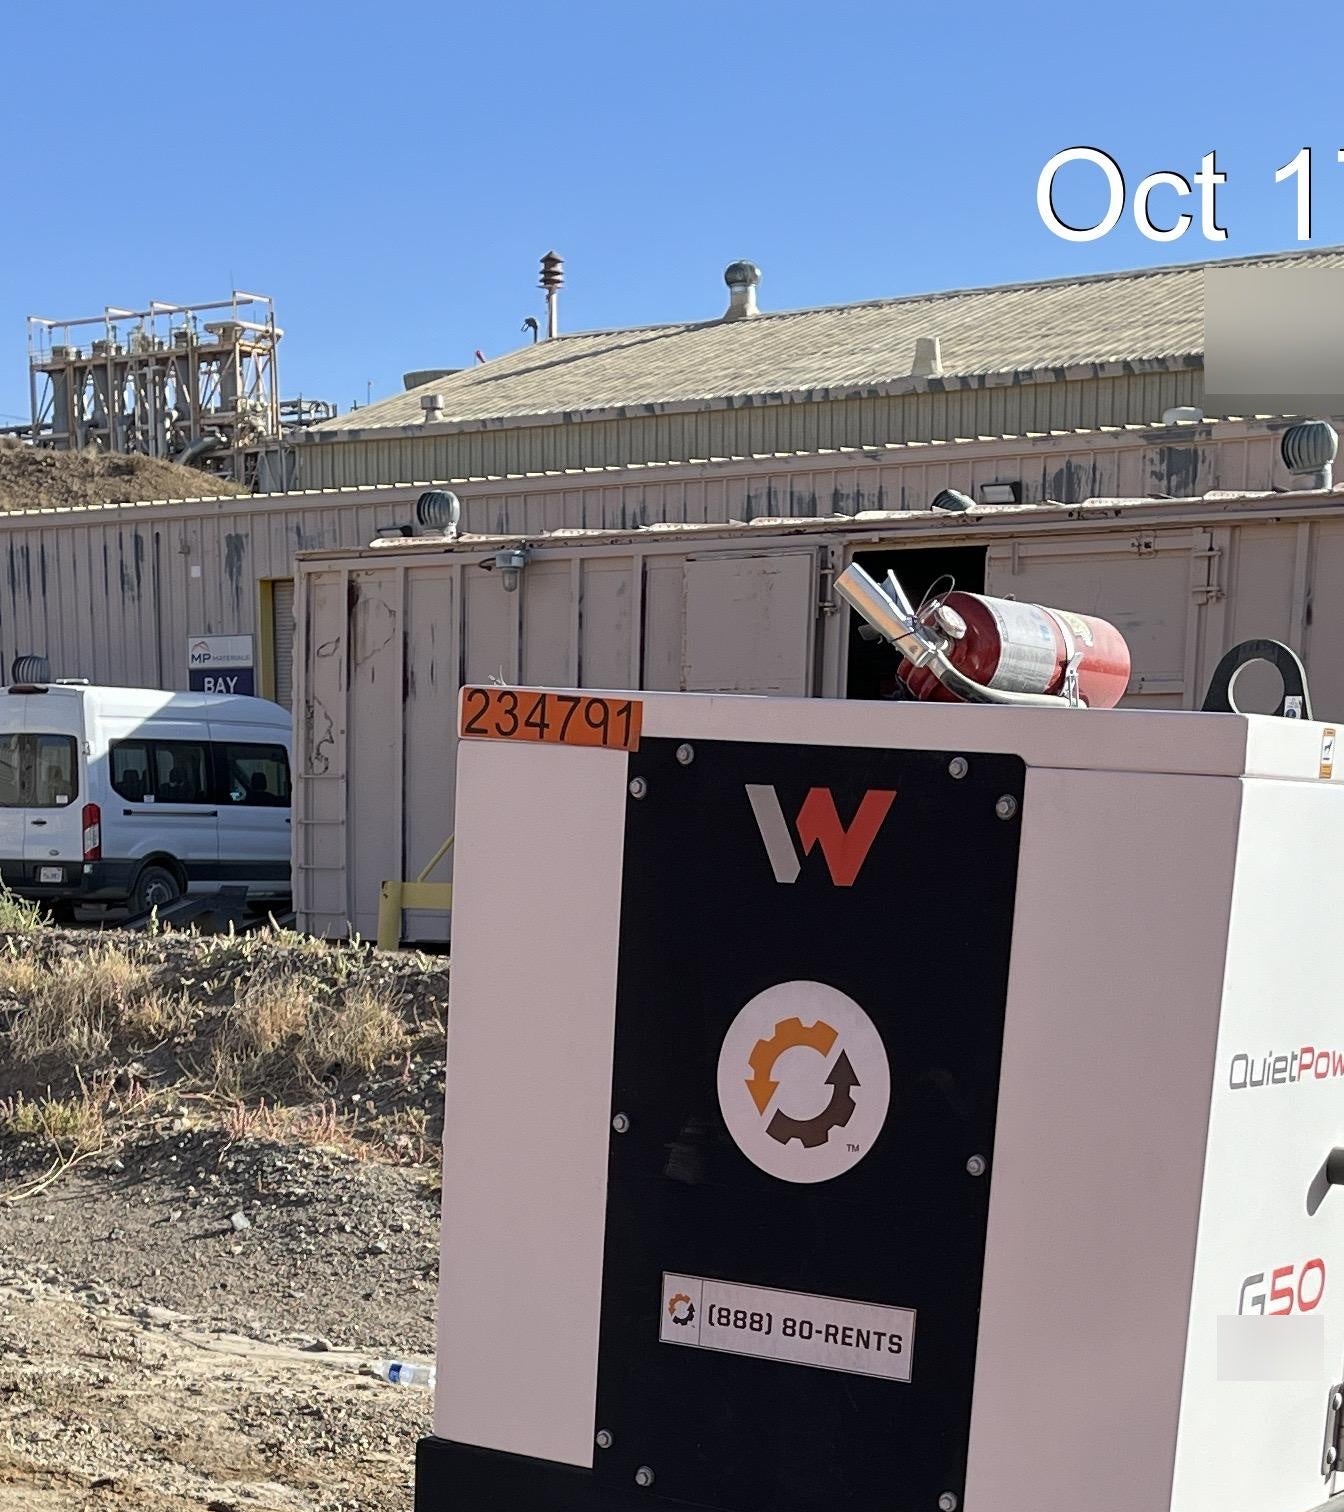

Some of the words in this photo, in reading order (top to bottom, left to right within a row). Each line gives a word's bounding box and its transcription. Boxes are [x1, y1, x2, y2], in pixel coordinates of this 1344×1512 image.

[191, 653, 212, 664] MP
[203, 676, 238, 694] BAY
[464, 688, 632, 747] 234791
[846, 1143, 860, 1152] TM
[1238, 1257, 1326, 1316] G50
[708, 1303, 773, 1336] (888)
[781, 1317, 904, 1354] 80-RENTS
